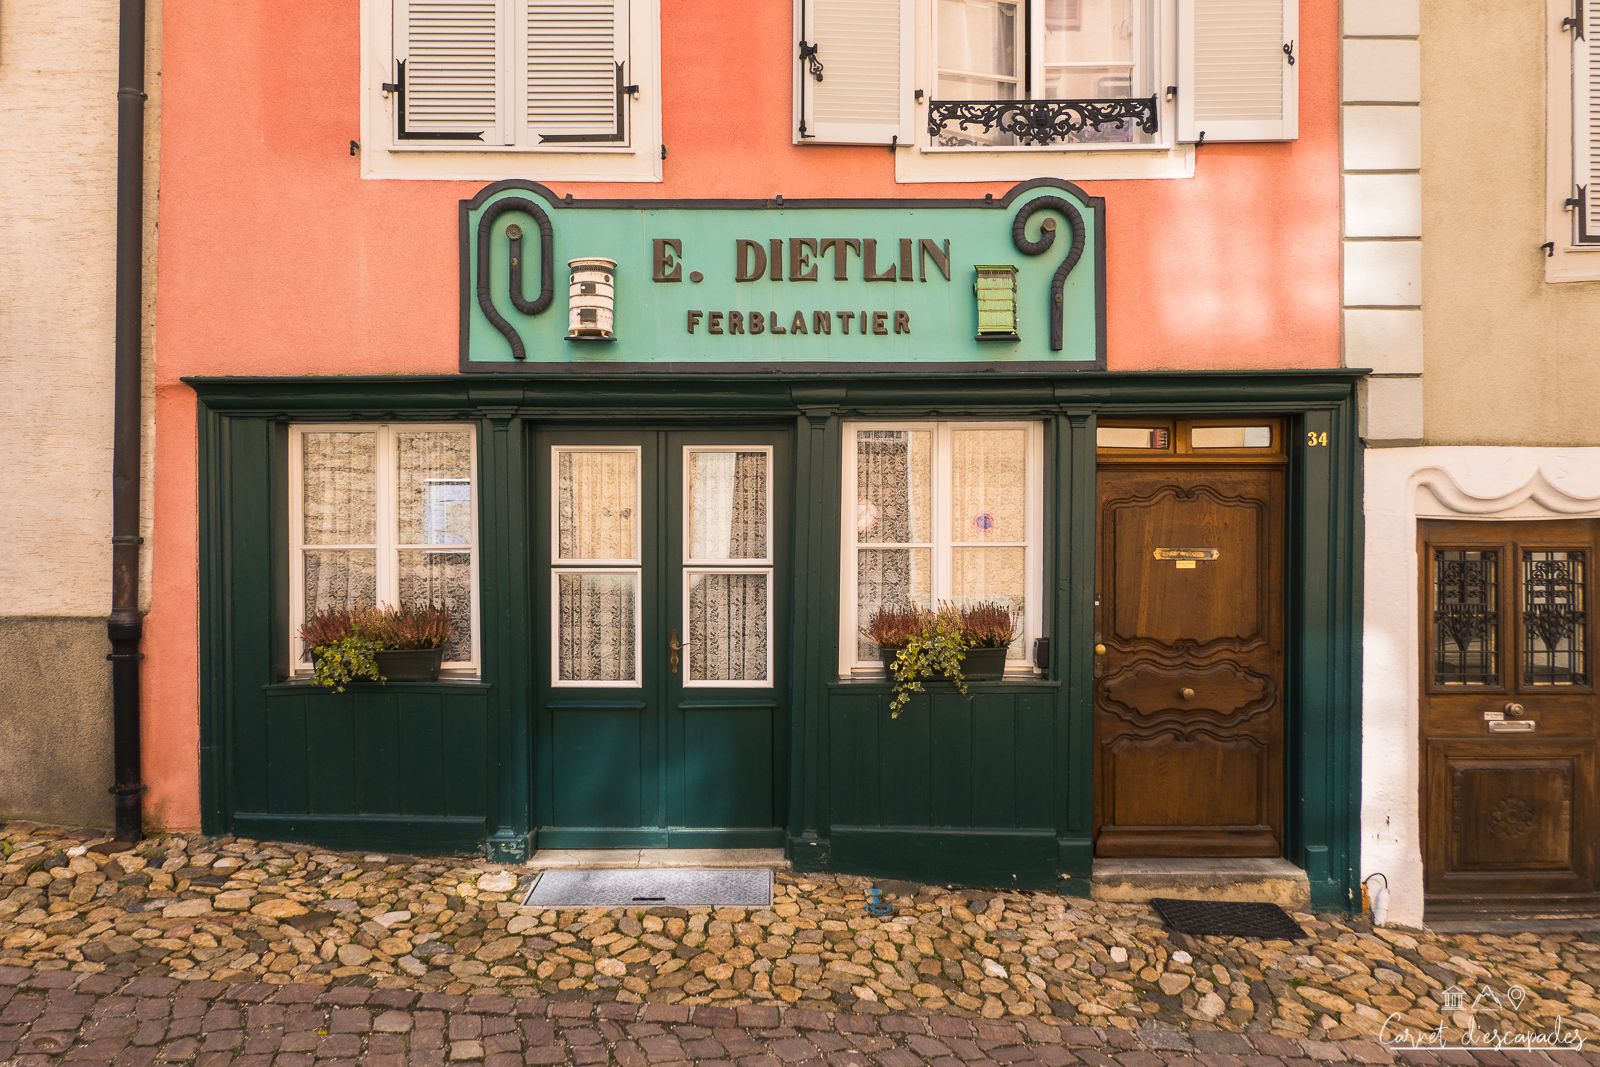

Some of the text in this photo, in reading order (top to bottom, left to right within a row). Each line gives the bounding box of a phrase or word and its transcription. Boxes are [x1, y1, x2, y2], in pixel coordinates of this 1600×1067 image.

[652, 237, 951, 283] E. DIETLIN
[687, 309, 911, 335] FERBLANTIER
[1307, 431, 1328, 447] 34
